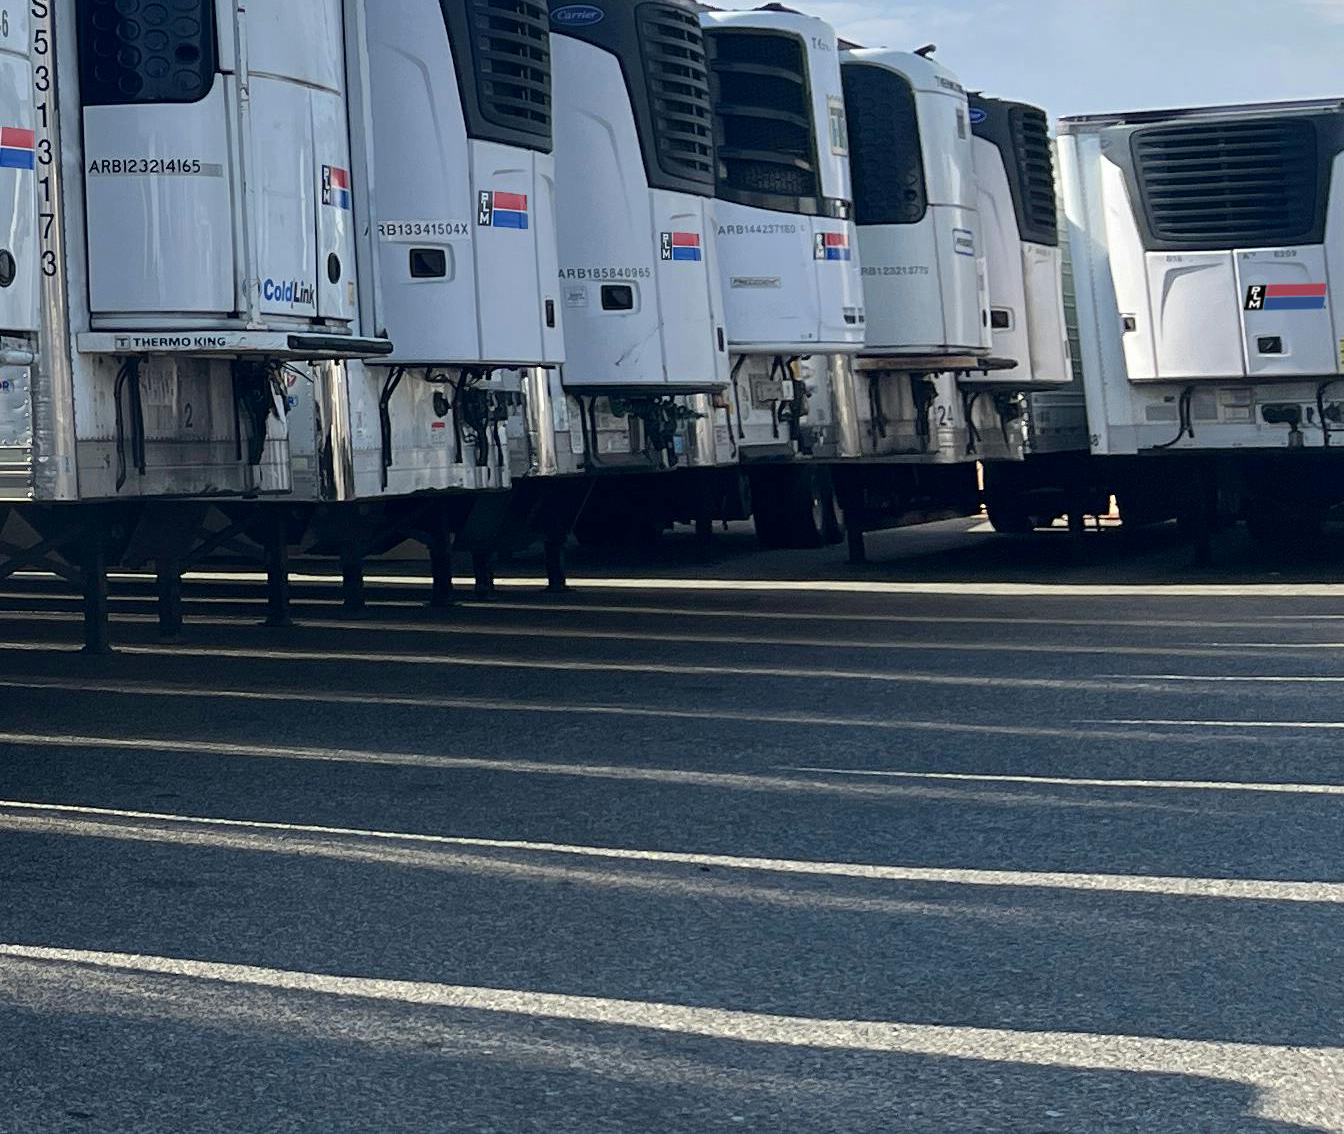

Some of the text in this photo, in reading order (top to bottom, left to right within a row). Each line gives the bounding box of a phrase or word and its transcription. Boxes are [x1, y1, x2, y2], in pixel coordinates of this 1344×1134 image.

[558, 11, 597, 20] Carrier
[89, 159, 201, 174] ARB123214165
[480, 192, 490, 224] PLM
[662, 234, 671, 259] PLM
[264, 278, 315, 309] ColdLink
[1249, 286, 1261, 309] PLM
[133, 337, 191, 347] THERMO
[194, 337, 226, 347] KING
